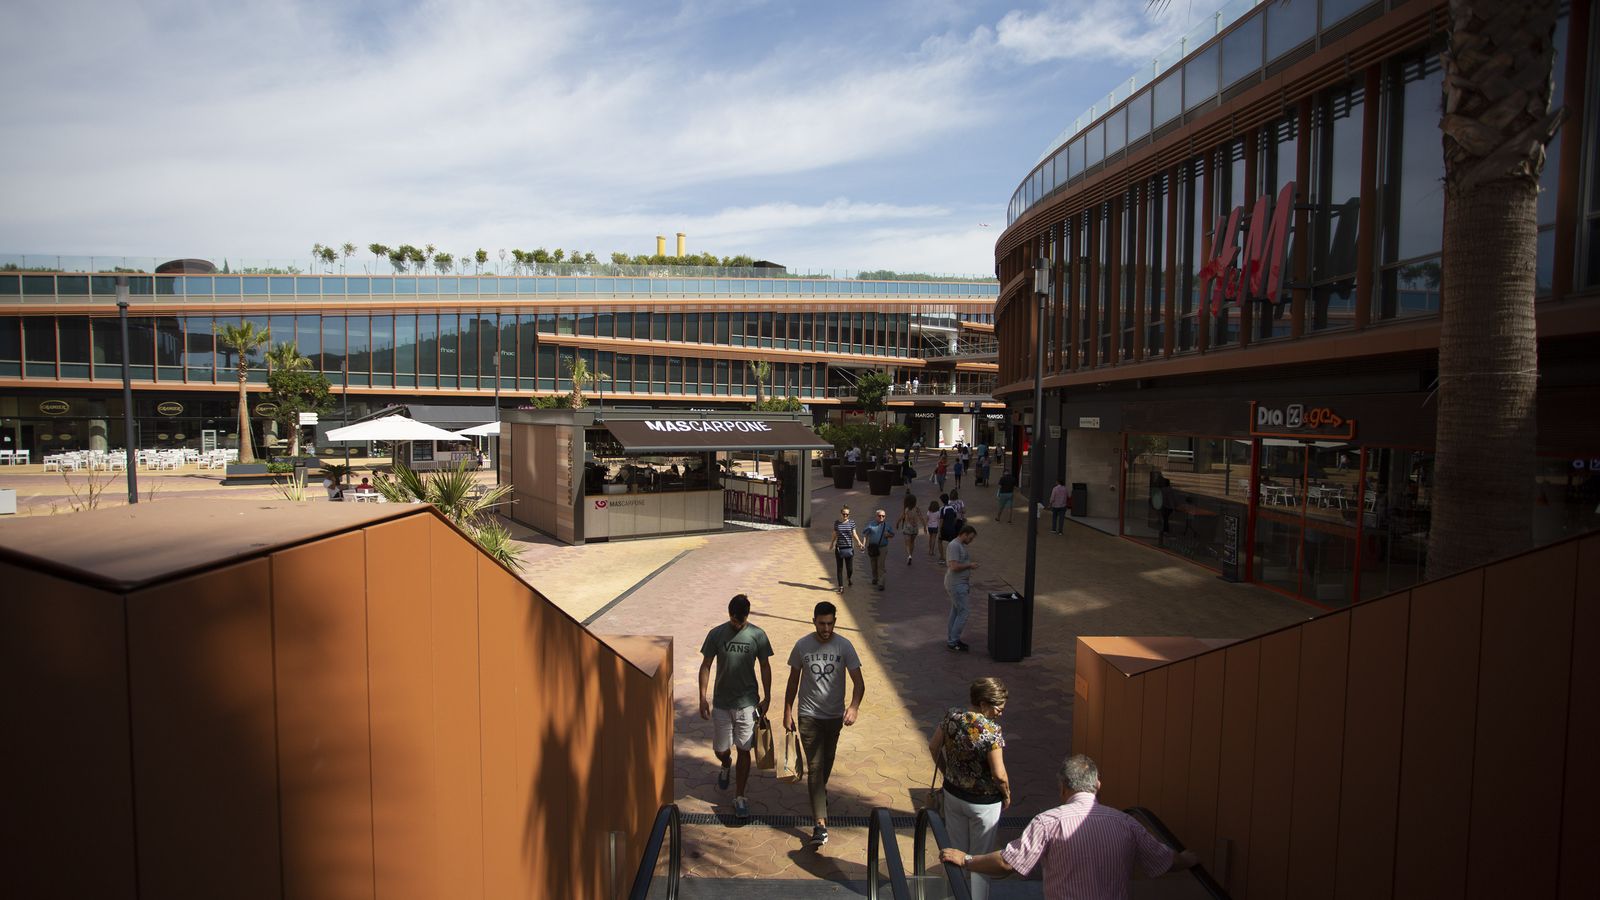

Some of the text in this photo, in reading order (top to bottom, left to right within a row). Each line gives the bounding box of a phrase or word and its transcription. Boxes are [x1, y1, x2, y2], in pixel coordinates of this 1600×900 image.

[1198, 181, 1296, 319] H&M
[644, 420, 772, 432] MASCARPONE
[724, 642, 750, 653] VANS
[804, 653, 841, 663] SILBON
